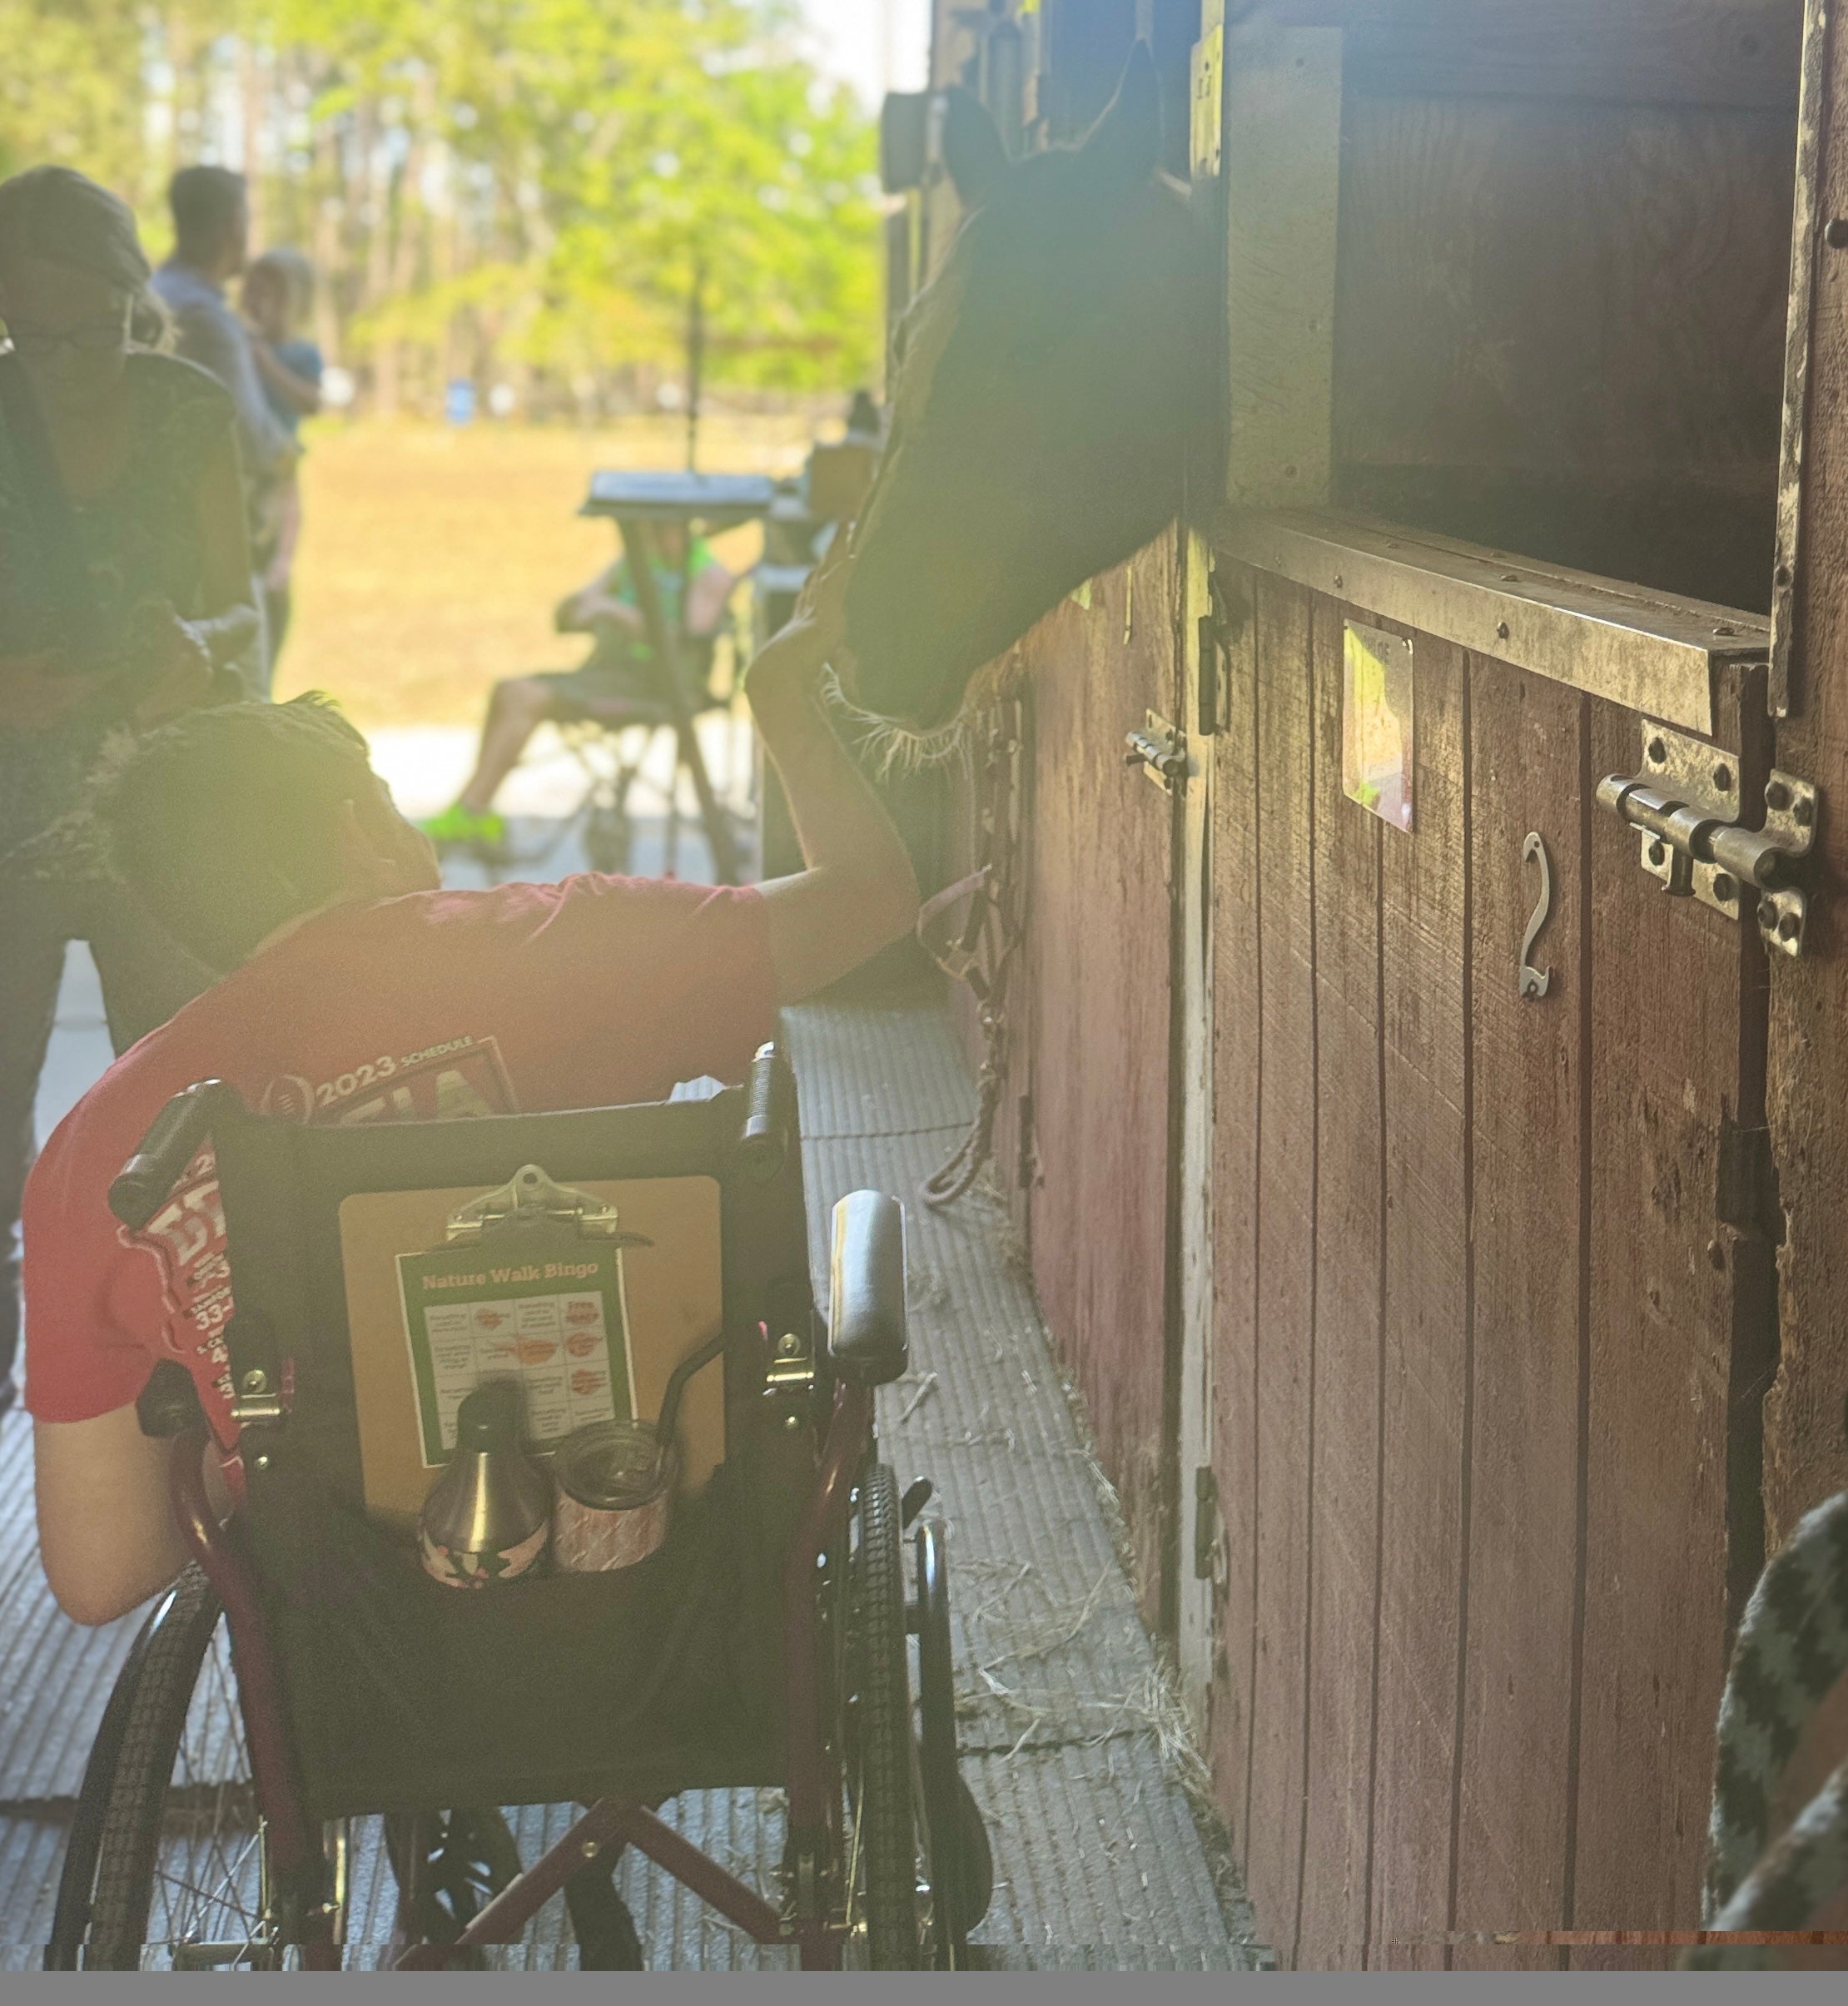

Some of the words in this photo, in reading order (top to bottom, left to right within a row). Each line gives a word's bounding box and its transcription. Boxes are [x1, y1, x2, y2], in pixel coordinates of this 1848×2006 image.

[315, 1055, 397, 1108] 2023
[400, 1035, 474, 1068] SCHEDULE
[422, 1273, 487, 1290] Nature
[489, 1264, 541, 1284] Walk
[544, 1262, 599, 1280] Bingo
